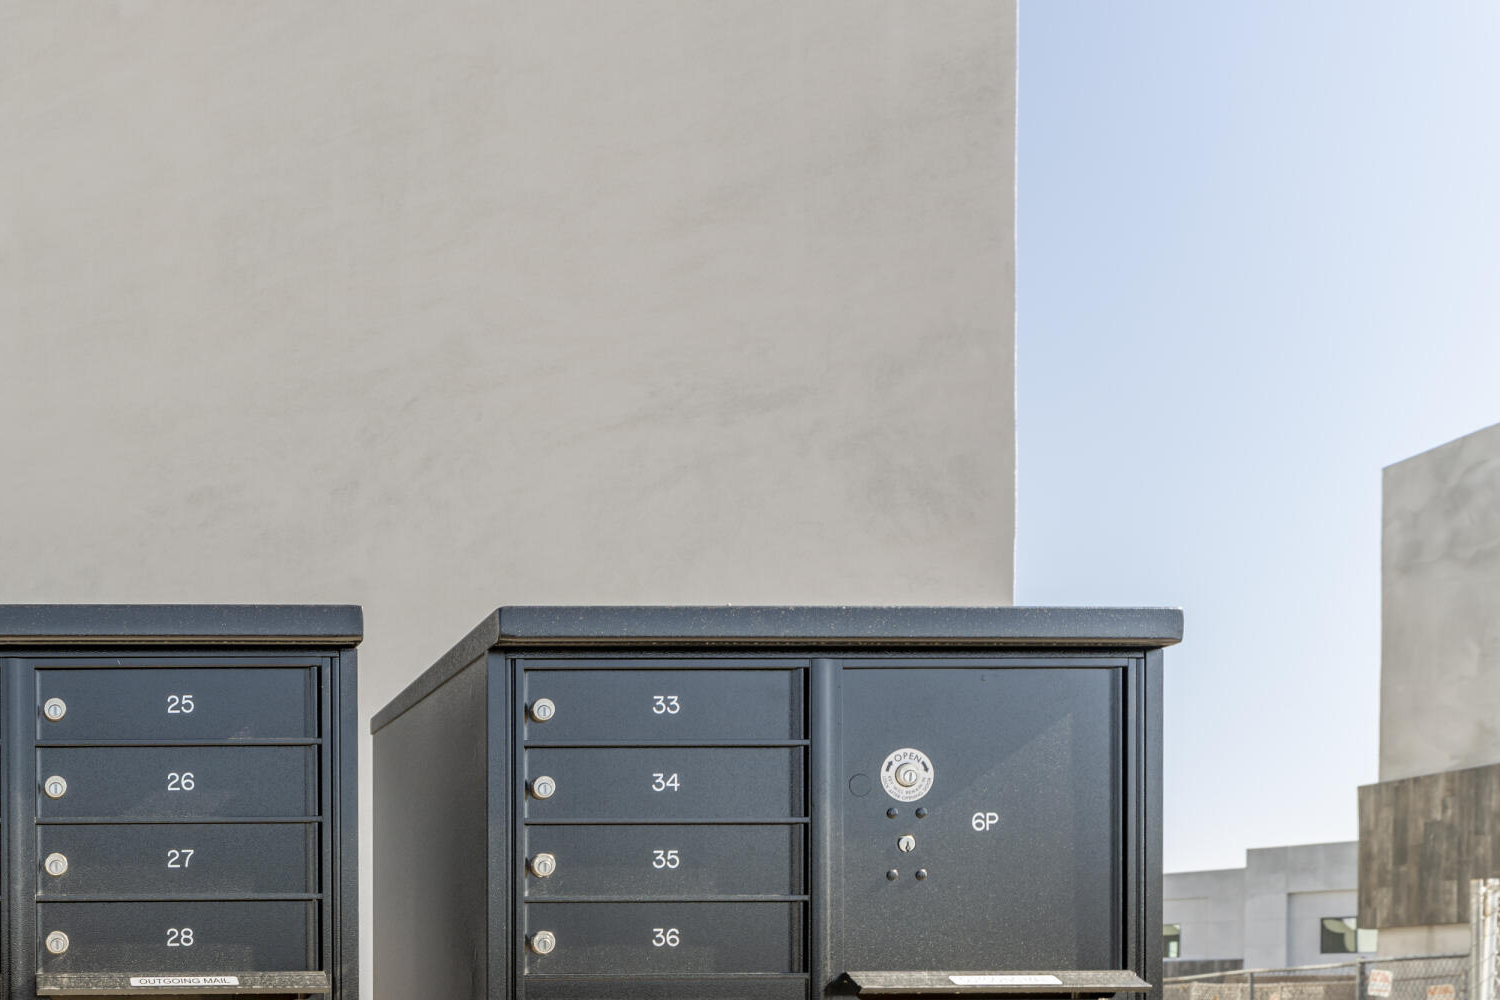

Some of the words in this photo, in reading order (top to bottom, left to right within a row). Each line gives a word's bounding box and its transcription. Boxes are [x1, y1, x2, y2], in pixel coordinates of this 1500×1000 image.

[167, 694, 195, 714] 25
[652, 695, 680, 715] 33
[894, 752, 923, 763] OPEN
[167, 772, 195, 791] 26
[651, 773, 681, 792] 34
[971, 812, 999, 832] 6P
[167, 849, 195, 868] 27
[652, 849, 680, 869] 35
[166, 927, 194, 947] 28
[652, 927, 680, 947] 36
